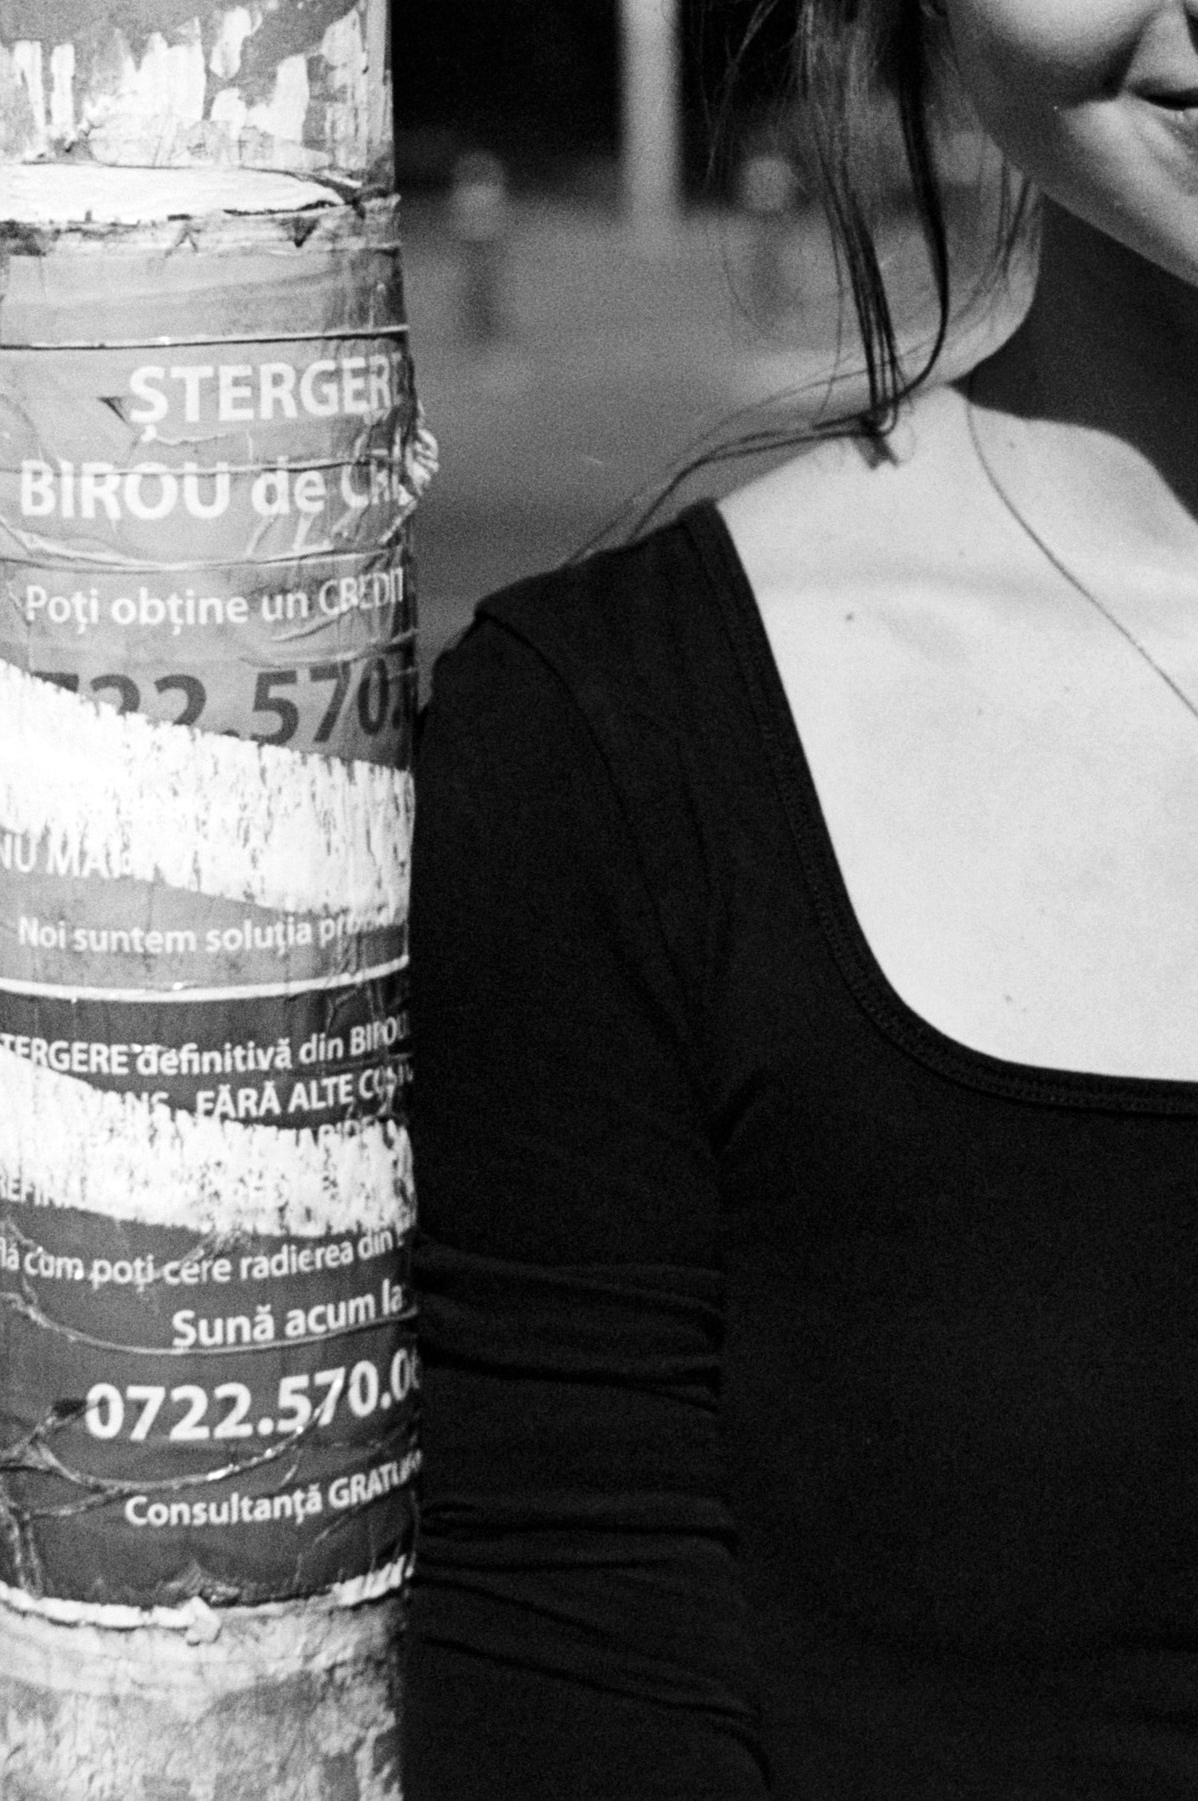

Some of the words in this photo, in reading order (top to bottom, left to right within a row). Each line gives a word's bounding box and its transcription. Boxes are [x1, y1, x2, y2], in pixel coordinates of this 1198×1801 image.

[20, 459, 231, 521] BIROU
[251, 456, 326, 516] de
[111, 587, 249, 636] obține
[262, 591, 309, 621] un
[18, 916, 66, 949] Noi
[75, 927, 197, 954] suntem
[205, 919, 312, 957] soluția
[136, 1036, 292, 1076] definitivă
[299, 1033, 343, 1065] din
[288, 1073, 353, 1113] ALTE
[24, 1246, 84, 1280] cum
[164, 1253, 231, 1283] cere
[240, 1242, 354, 1281] radierea
[357, 1229, 393, 1262] din
[171, 1303, 274, 1348] Sună
[284, 1292, 376, 1337] acum
[381, 1278, 402, 1316] la
[125, 1483, 322, 1525] Consultanță
